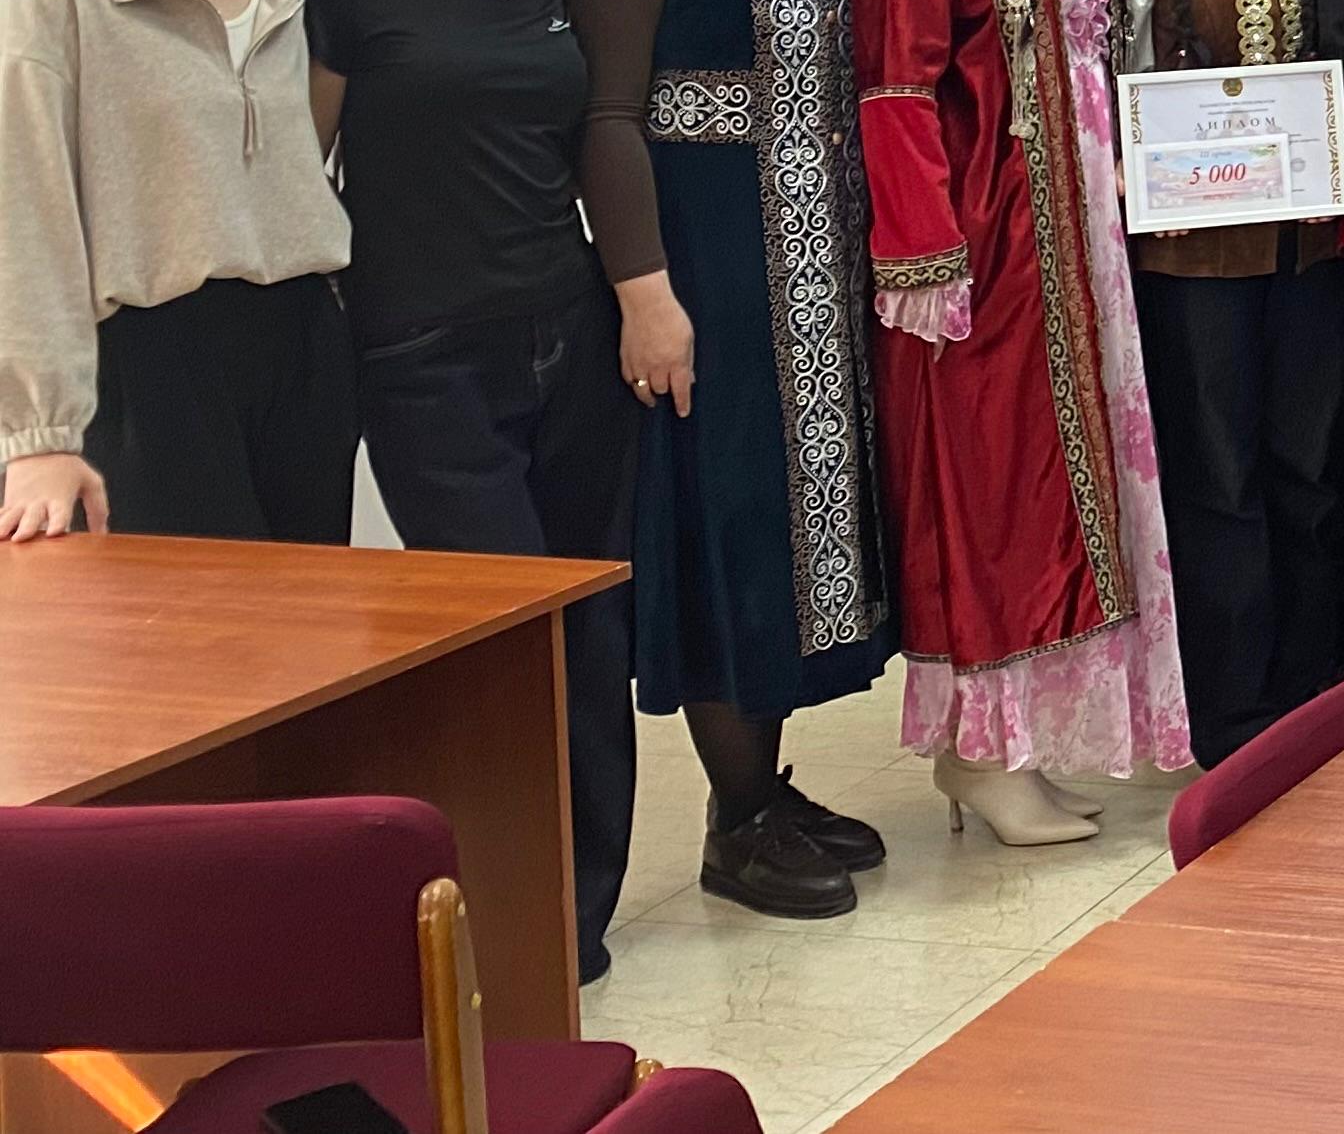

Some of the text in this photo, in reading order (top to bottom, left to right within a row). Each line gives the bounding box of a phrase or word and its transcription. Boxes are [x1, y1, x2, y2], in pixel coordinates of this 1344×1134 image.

[1194, 117, 1276, 132] ДИПЛОМ
[1190, 163, 1246, 186] 5 000
